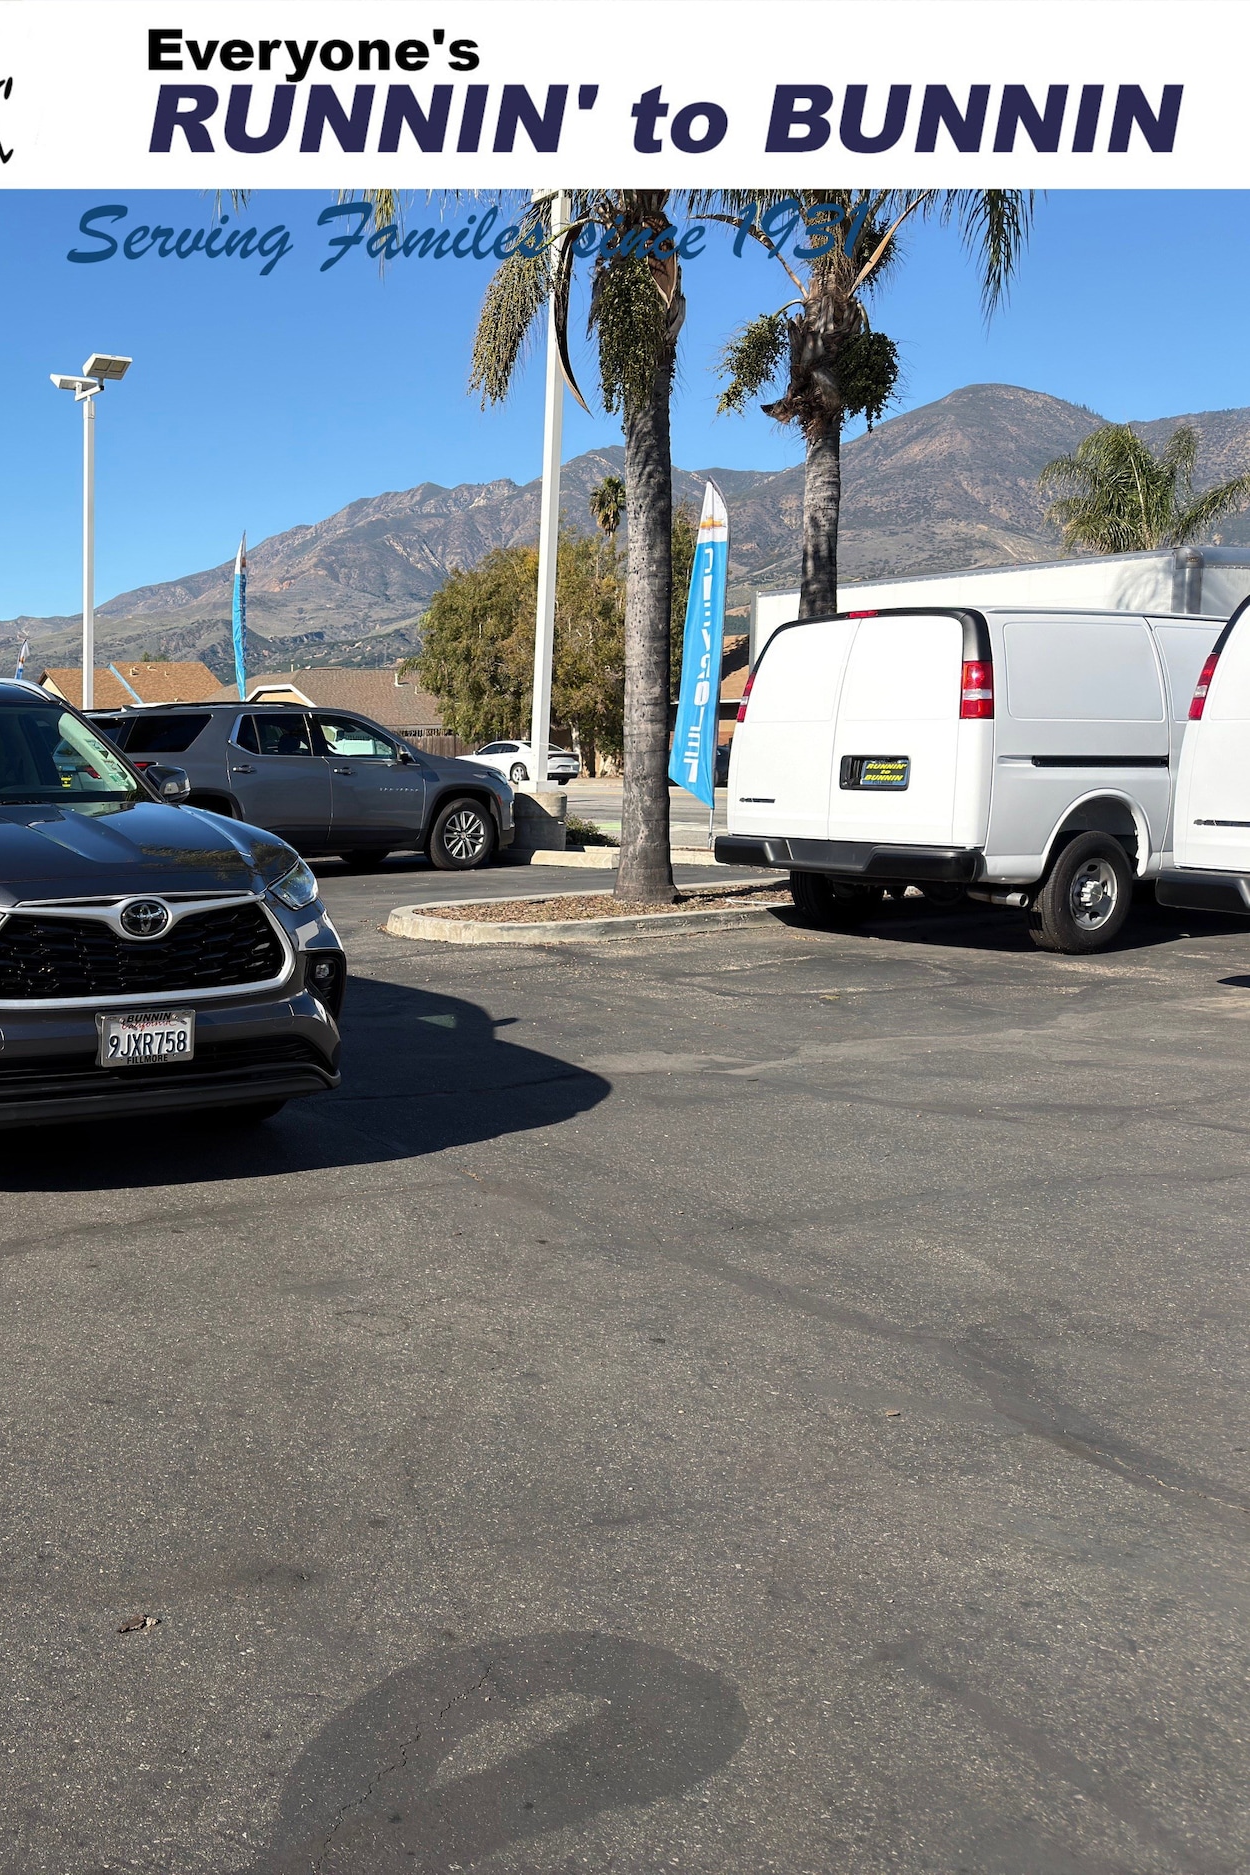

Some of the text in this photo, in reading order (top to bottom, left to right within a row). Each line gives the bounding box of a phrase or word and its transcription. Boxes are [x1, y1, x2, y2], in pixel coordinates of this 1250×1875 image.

[126, 1012, 171, 1023] BUNNIN
[108, 1030, 187, 1058] 9JXR758
[126, 1054, 168, 1065] FILLMORE
